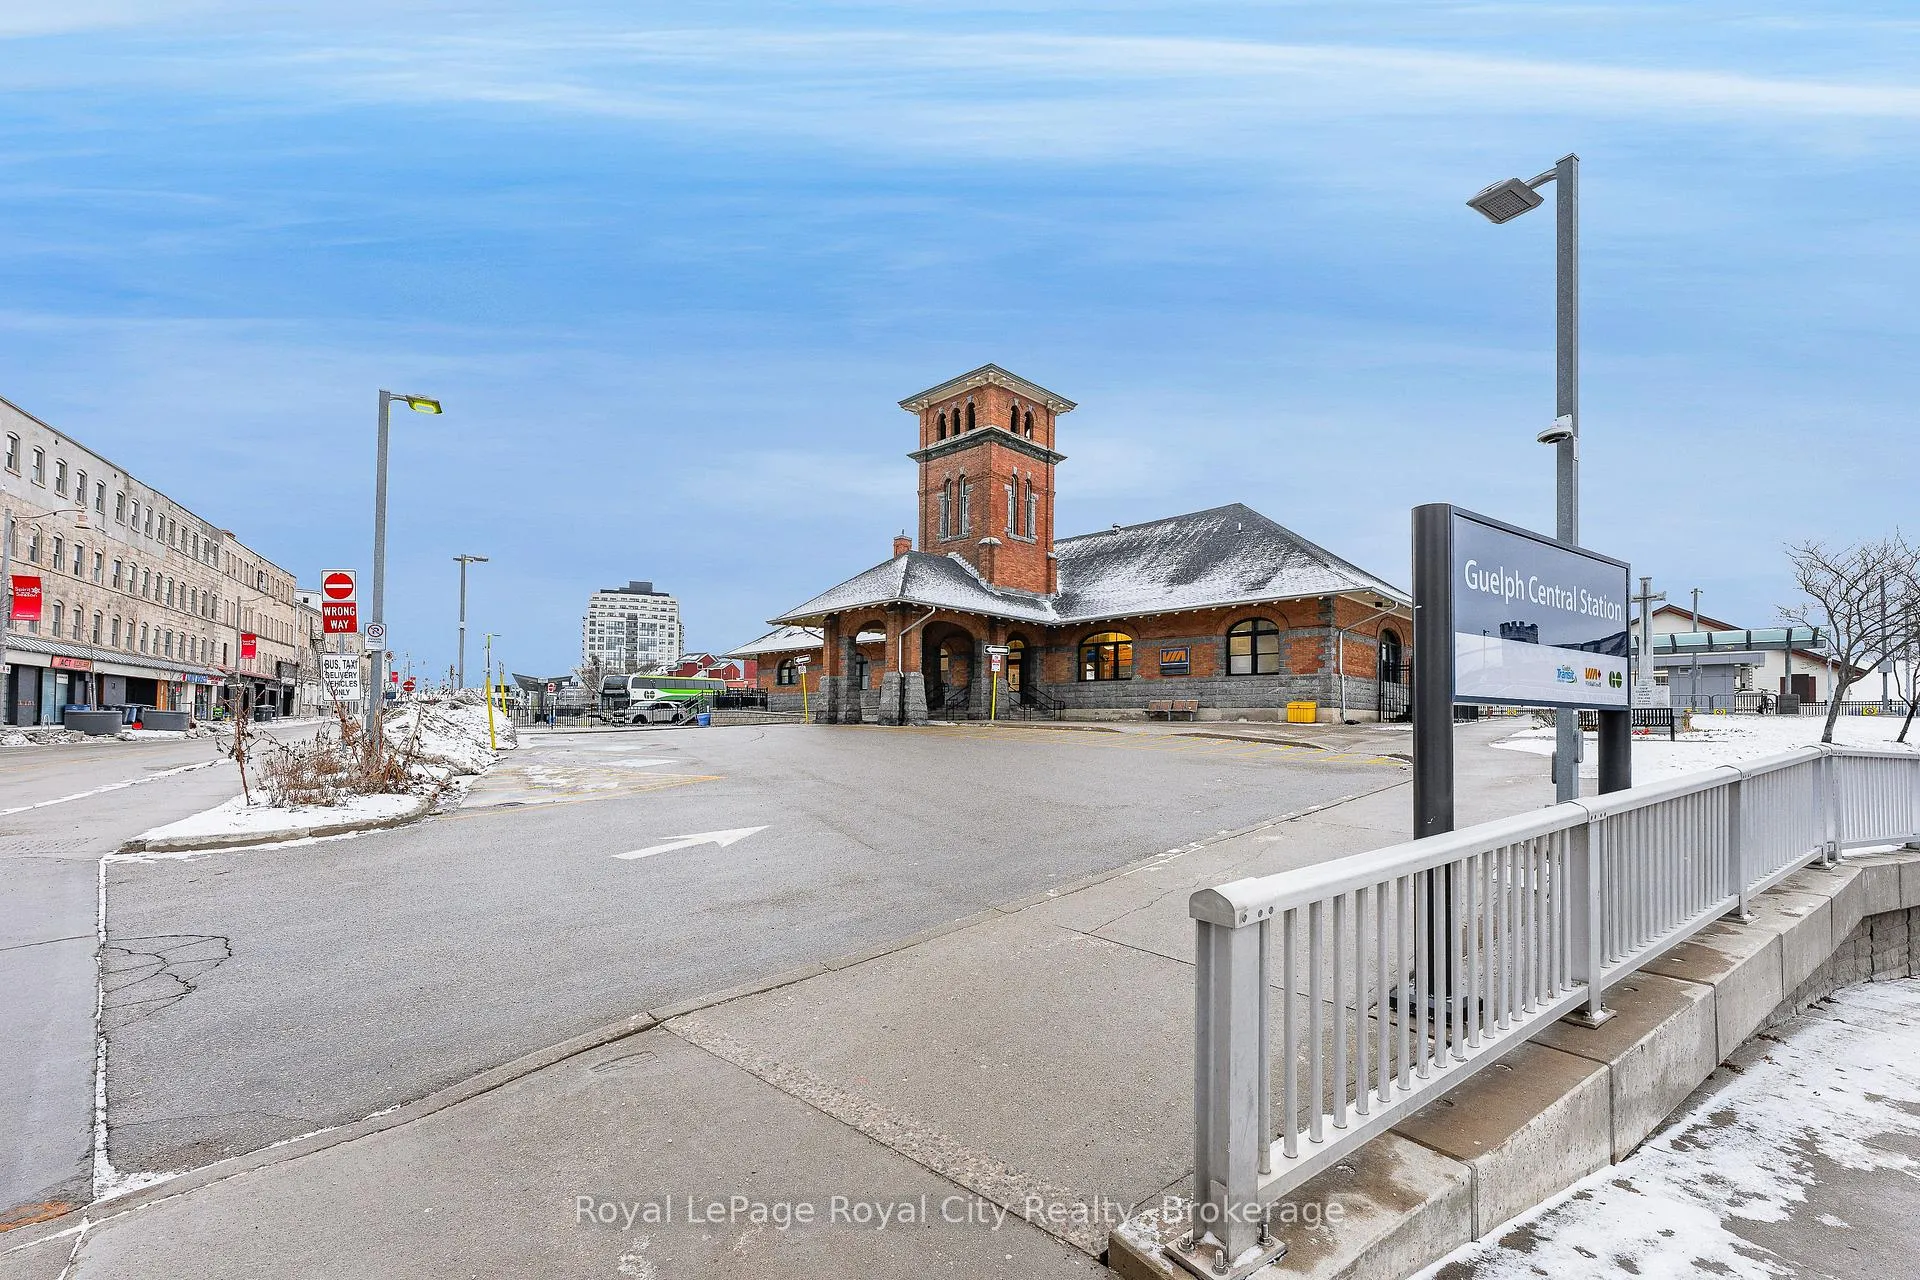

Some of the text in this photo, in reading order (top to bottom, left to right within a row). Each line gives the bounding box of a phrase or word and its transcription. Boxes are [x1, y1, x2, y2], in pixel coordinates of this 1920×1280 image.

[1464, 559, 1622, 621] Guelph Central Station
[323, 606, 356, 616] WRONG
[330, 619, 349, 629] WAY
[1162, 650, 1186, 663] VIA
[325, 671, 358, 679] DELIVERY
[325, 680, 358, 688] VEHICLES
[334, 688, 350, 696] ONLY
